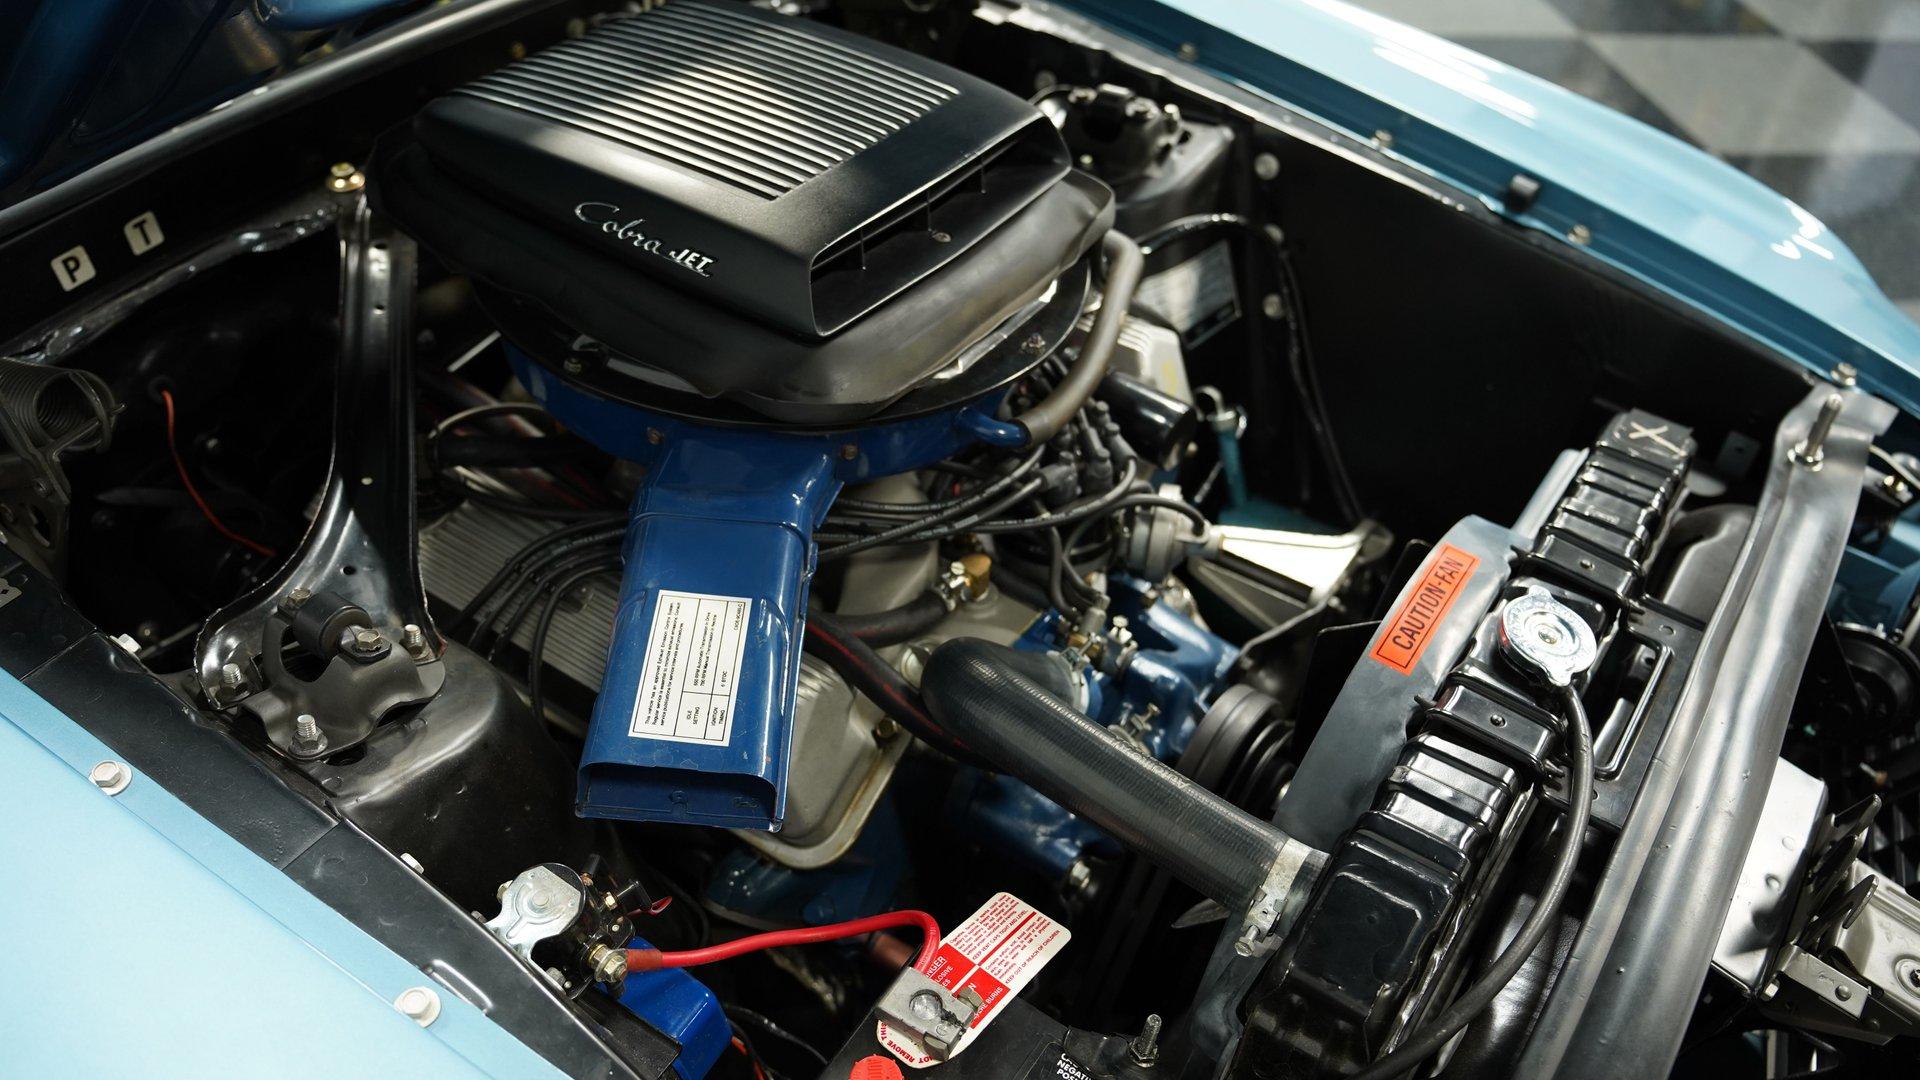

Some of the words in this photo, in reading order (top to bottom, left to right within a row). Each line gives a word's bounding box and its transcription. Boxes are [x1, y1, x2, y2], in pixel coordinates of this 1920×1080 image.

[132, 219, 151, 246] T
[575, 202, 663, 255] Cobra
[669, 248, 714, 275] JET
[62, 256, 80, 284] P
[1392, 556, 1464, 651] CAUTION-FAN
[926, 955, 947, 978] NGER
[936, 965, 954, 983] LOSIVE
[985, 986, 1004, 1004] BURNS
[886, 1040, 915, 1064] REMOVE
